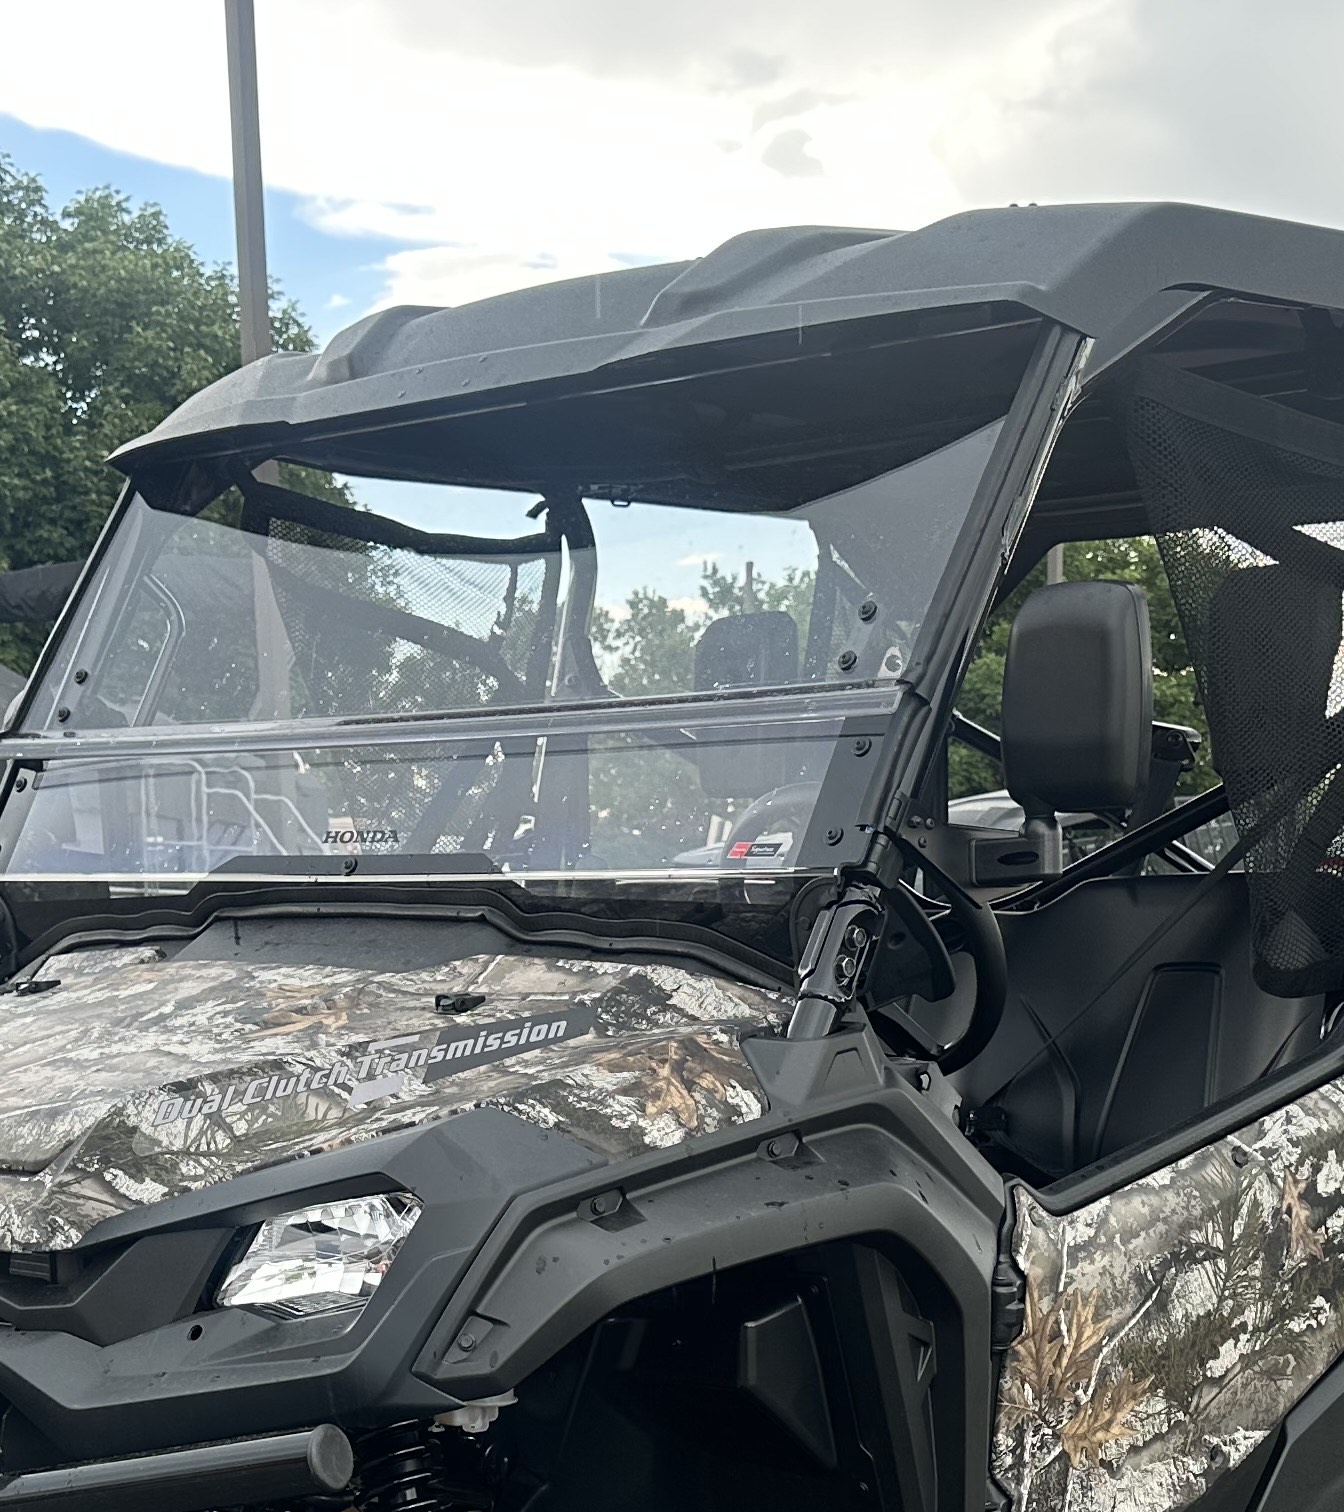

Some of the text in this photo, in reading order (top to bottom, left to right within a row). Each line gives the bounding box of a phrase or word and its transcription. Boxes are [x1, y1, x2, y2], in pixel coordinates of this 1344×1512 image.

[322, 830, 400, 844] HONDA
[153, 1020, 568, 1127] Dual Clutch Transmission
